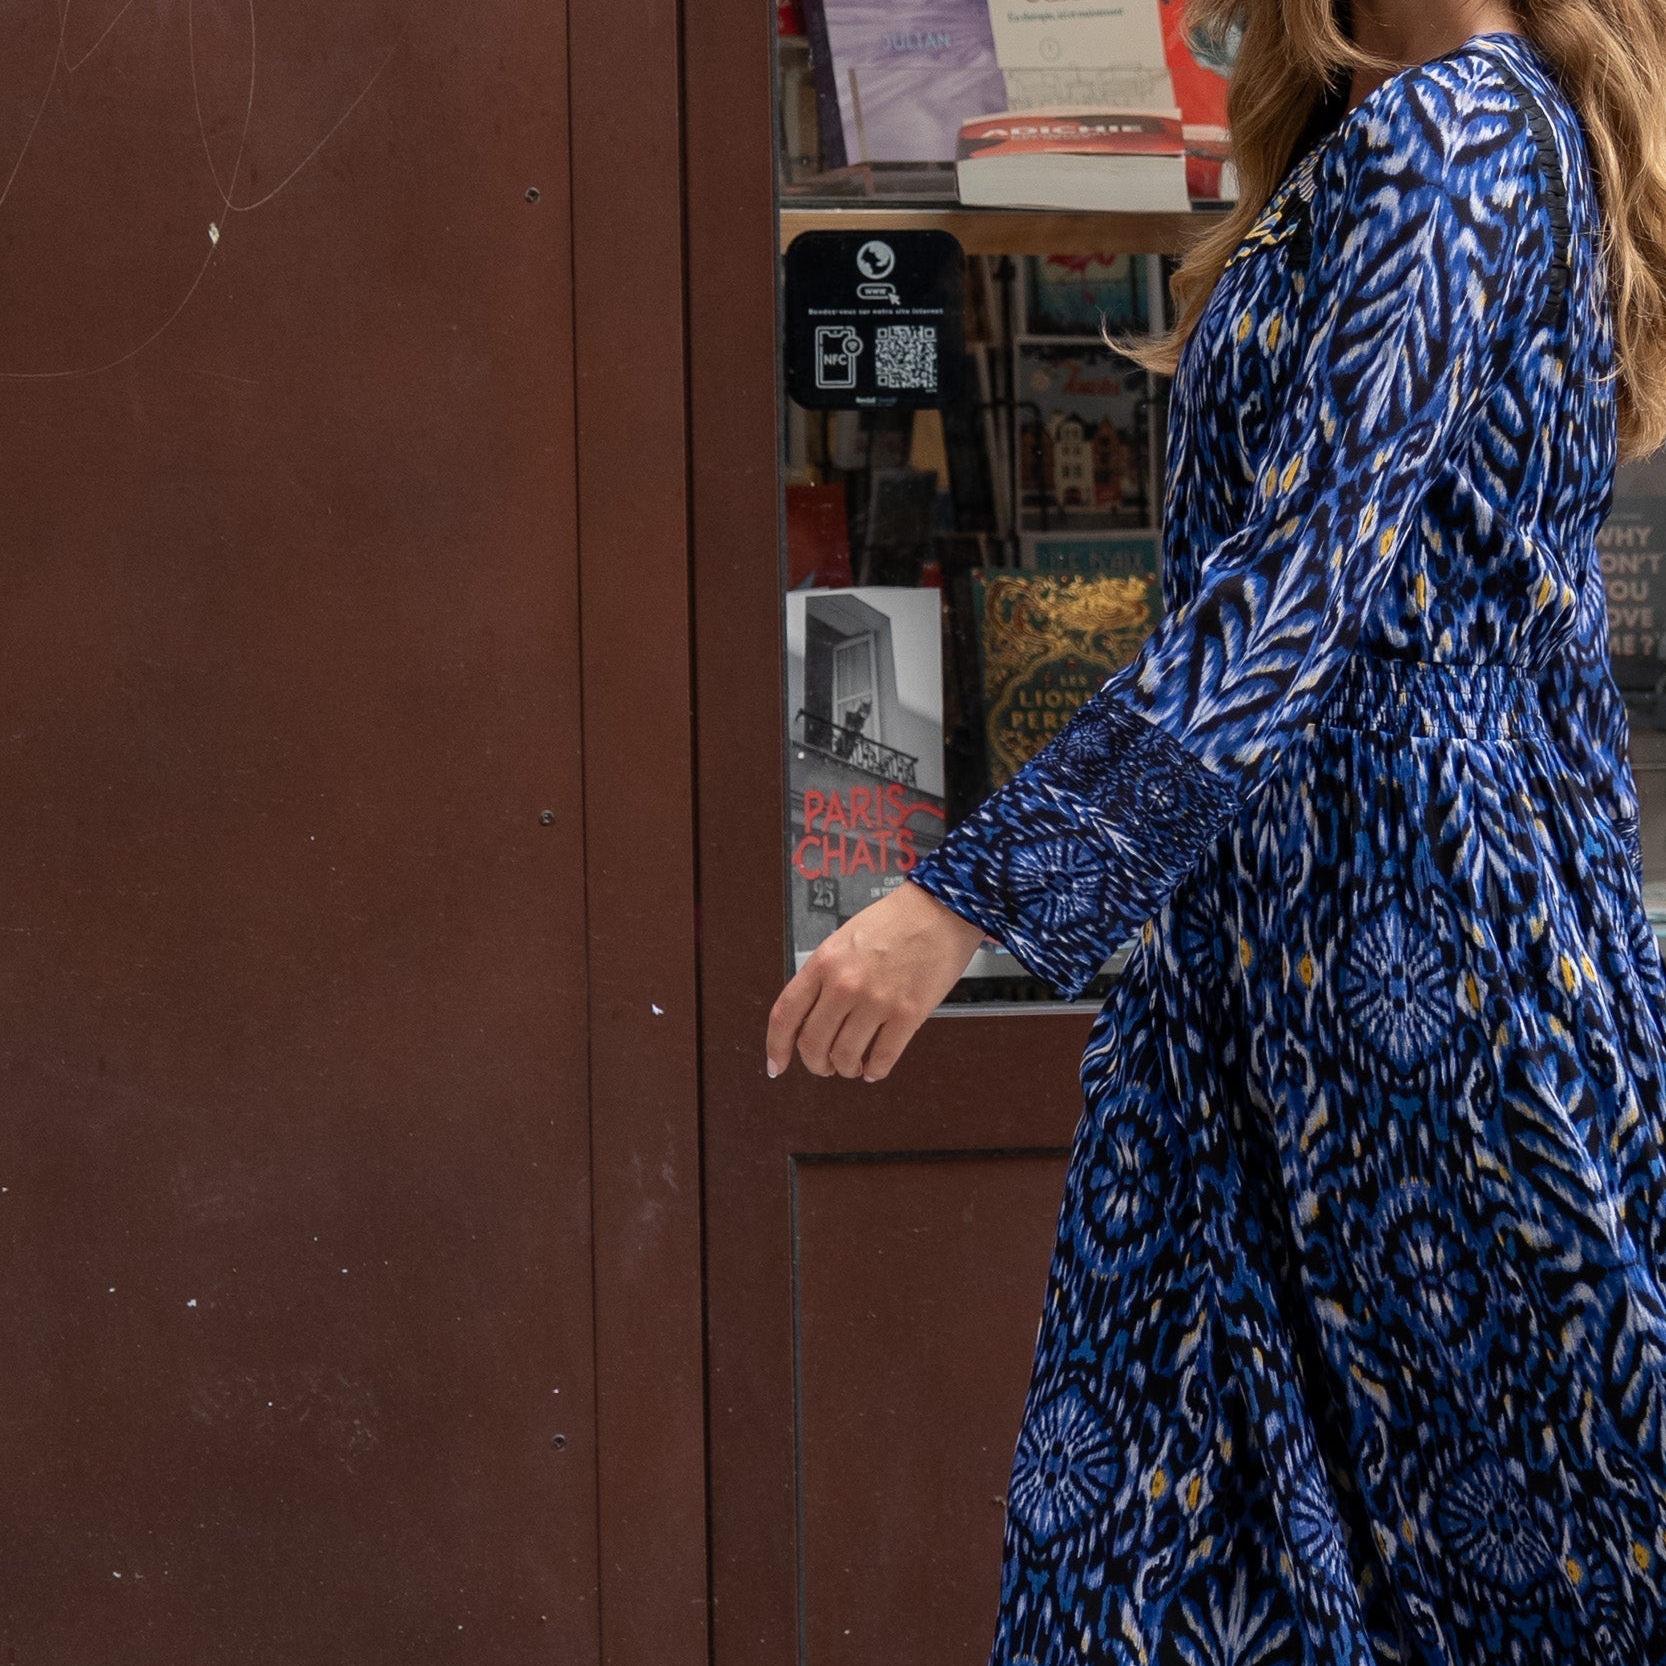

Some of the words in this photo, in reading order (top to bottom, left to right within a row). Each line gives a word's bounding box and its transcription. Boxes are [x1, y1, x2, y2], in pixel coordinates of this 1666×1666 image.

[883, 32, 951, 52] JULIAN
[982, 124, 1143, 139] ADICHIE
[823, 353, 848, 366] NFC
[1600, 552, 1666, 575] ON'T
[1604, 579, 1650, 603] OU
[1608, 606, 1655, 629] OVE
[804, 782, 908, 834] PARIS
[793, 828, 918, 880] CHATS
